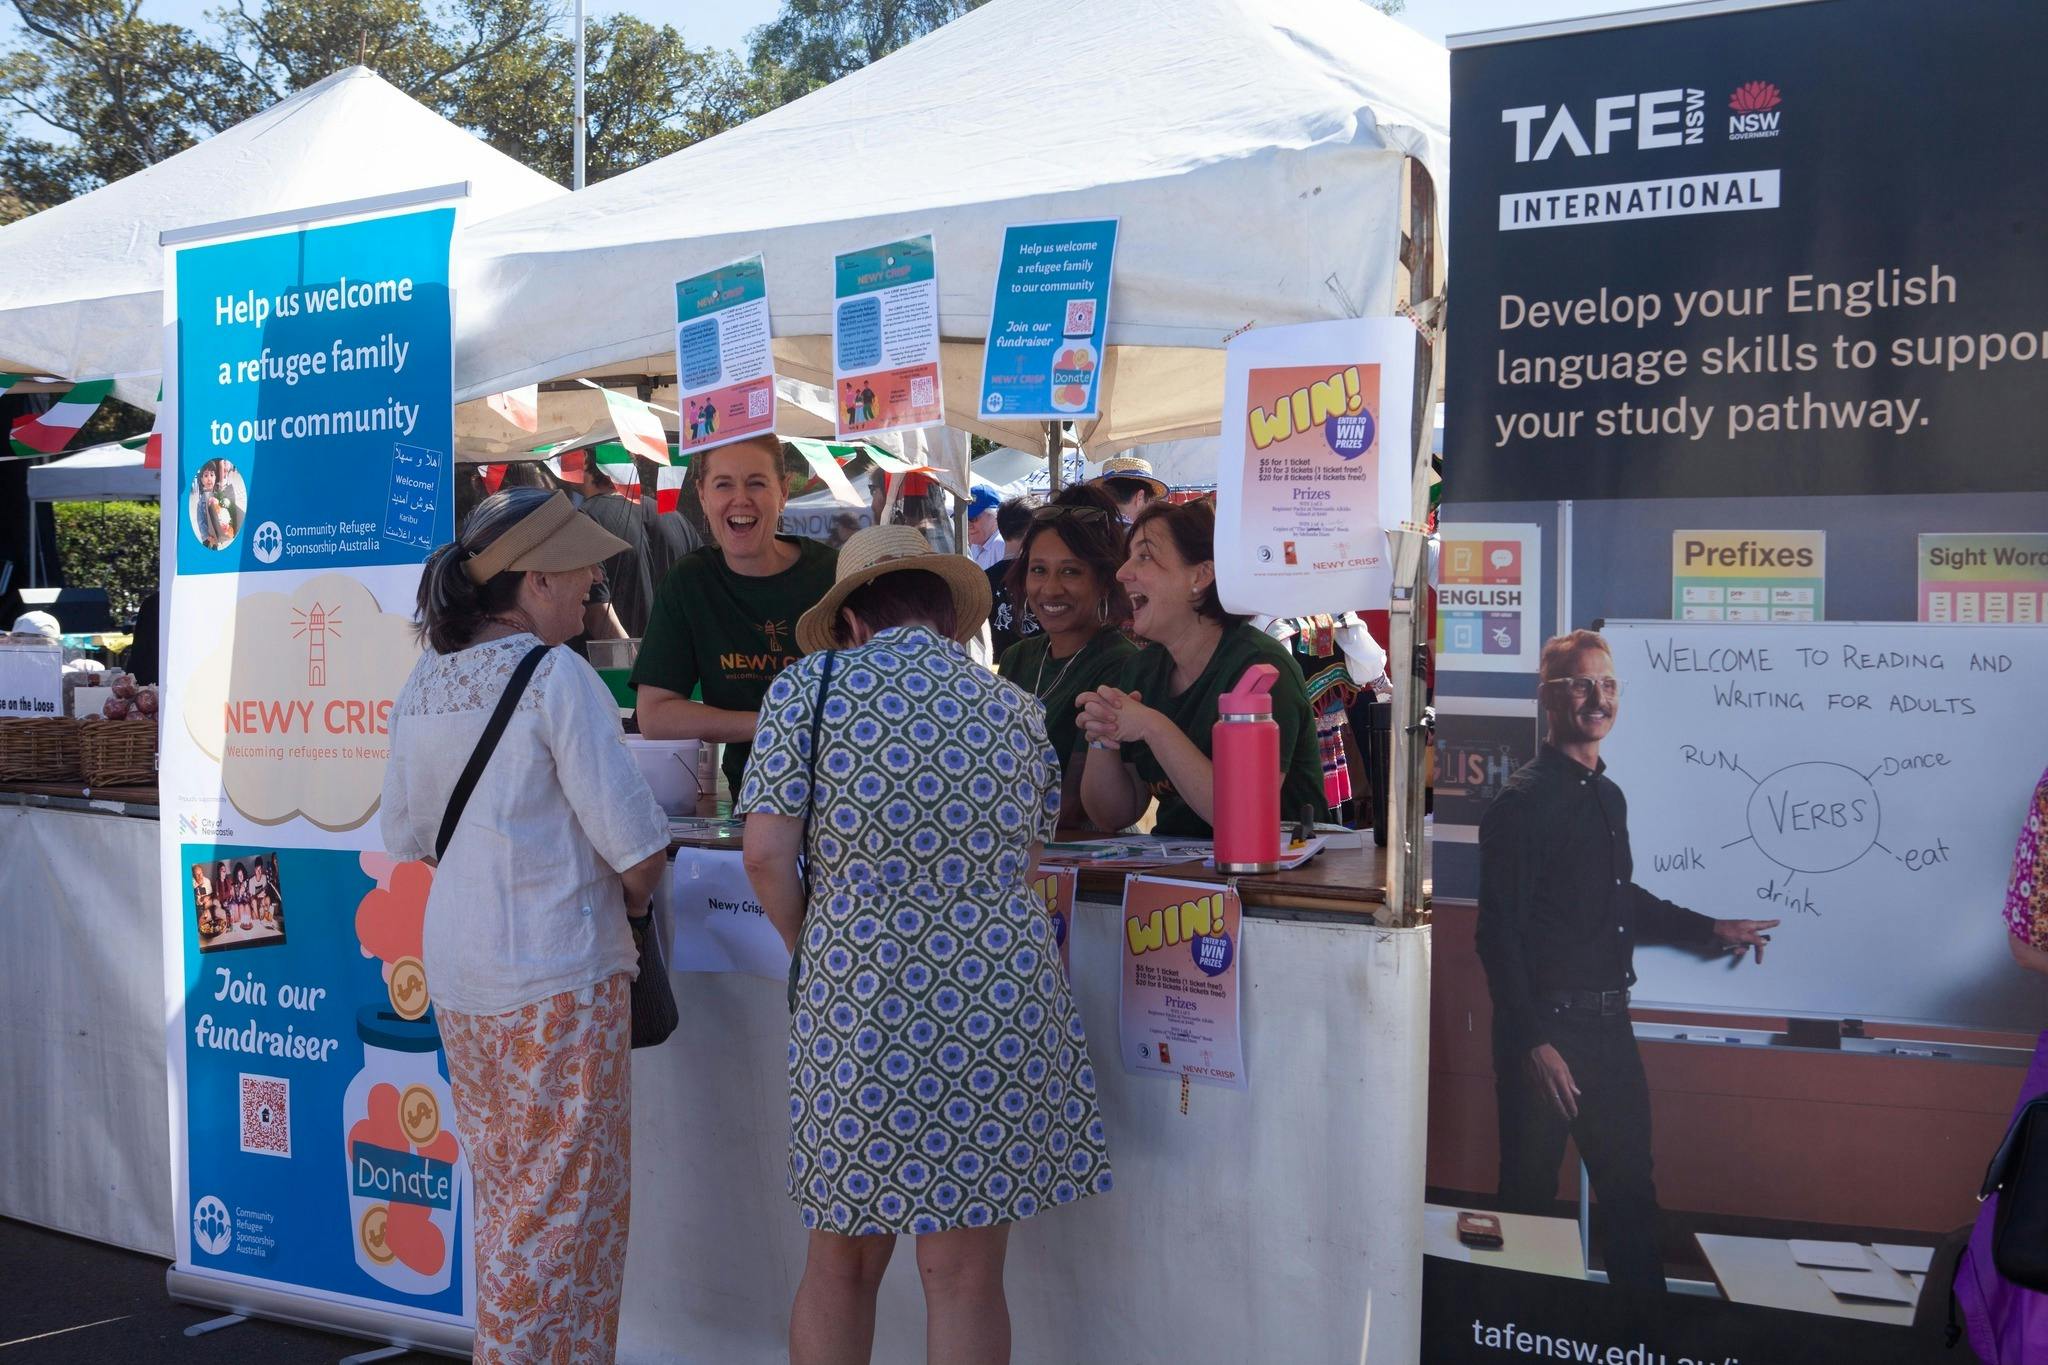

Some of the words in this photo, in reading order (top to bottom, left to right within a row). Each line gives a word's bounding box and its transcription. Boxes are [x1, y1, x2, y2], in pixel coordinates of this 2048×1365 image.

[1685, 88, 1705, 145] NSW
[1729, 111, 1781, 135] NSW
[1501, 88, 1684, 163] TAFE
[1729, 130, 1780, 141] GOVERNMENT
[1514, 178, 1763, 223] INTERNATIONAL
[1020, 244, 1042, 256] Help
[1044, 244, 1054, 253] us
[1056, 241, 1097, 252] welcome
[1025, 262, 1061, 274] refugee
[1063, 259, 1093, 272] family
[1012, 284, 1021, 292] to
[1022, 284, 1038, 292] our
[1040, 279, 1094, 292] community
[216, 290, 269, 328] Help
[276, 292, 299, 318] us
[305, 276, 412, 313] welcome
[1500, 287, 1661, 331] Develop
[1673, 286, 1773, 327] your
[1787, 265, 1956, 318] English
[1006, 321, 1028, 332] Join
[1032, 323, 1051, 331] our
[997, 336, 1053, 347] fundraiser
[219, 363, 231, 385] a
[238, 348, 326, 386] refugee
[332, 333, 409, 373] family
[1498, 349, 1687, 390] language
[1701, 335, 1818, 375] skills
[1833, 336, 1876, 368] to
[1055, 372, 1089, 383] Donate
[1250, 366, 1362, 450] WIN!
[211, 419, 233, 445] to
[238, 416, 276, 442] our
[281, 398, 419, 439] community
[1338, 417, 1357, 425] ENTER
[1358, 417, 1366, 425] TO
[1495, 411, 1585, 447] your
[1596, 396, 1714, 440] study
[1728, 392, 1929, 439] pathway.
[1336, 425, 1365, 440] WIN
[1335, 440, 1362, 448] PRIZES
[1344, 466, 1363, 474] free!)
[1348, 474, 1366, 482] free!)
[395, 474, 434, 491] Welcome!
[1293, 487, 1330, 500] Prizes
[285, 523, 337, 538] Community
[340, 521, 376, 537] Refugee
[286, 542, 337, 556] Sponsorship
[339, 538, 380, 552] Australia
[1685, 541, 1813, 566] Prefixes
[1313, 561, 1345, 570] NEWY
[1348, 557, 1379, 566] CRISP
[1930, 548, 1987, 569] Sight
[1439, 590, 1521, 605] ENGLISH
[720, 654, 776, 670] NEWY
[1645, 640, 1774, 673] WELCOME
[1796, 646, 1829, 668] TO
[1843, 644, 1944, 673] READING
[1969, 653, 2012, 673] AND
[8, 700, 17, 710] on
[20, 696, 31, 710] the
[34, 697, 54, 712] Loose
[1714, 682, 1804, 711] WRITING
[1828, 693, 1873, 710] FOR
[1890, 694, 1977, 715] ADULTS
[224, 700, 314, 734] NEWY
[227, 745, 283, 760] Welcoming
[289, 746, 338, 760] refugees
[342, 746, 353, 759] to
[1680, 744, 1741, 772] RUN
[1434, 751, 1509, 785] LISH
[1768, 792, 1868, 834] VERBS
[202, 818, 215, 827] City
[202, 828, 233, 836] Newcastle
[1654, 846, 1706, 873] walk
[1904, 840, 1951, 872] eat
[1757, 879, 1822, 918] drink
[708, 898, 739, 914] Newy
[742, 901, 765, 917] Crisp
[1127, 893, 1225, 955] WIN!
[1202, 937, 1218, 945] ENTER
[1201, 944, 1225, 959] WIN
[1200, 958, 1222, 968] PRIZES
[1162, 968, 1179, 976] ticket
[214, 967, 266, 1007] Join
[278, 985, 326, 1012] our
[1163, 976, 1180, 984] tickets
[1190, 979, 1205, 987] ticket
[1163, 983, 1180, 991] tickets
[1190, 986, 1209, 996] tickets
[1165, 996, 1197, 1010] Prizes
[195, 1014, 338, 1062] fundraiser
[1183, 1065, 1208, 1076] NEWY
[1210, 1069, 1235, 1079] CRISP
[359, 1156, 449, 1200] Donate
[236, 1206, 274, 1224] Community
[236, 1219, 263, 1234] Refugee
[236, 1232, 275, 1247] Sponsorship
[236, 1244, 266, 1257] Australia
[1472, 1319, 1739, 1365] tafensw.edu
